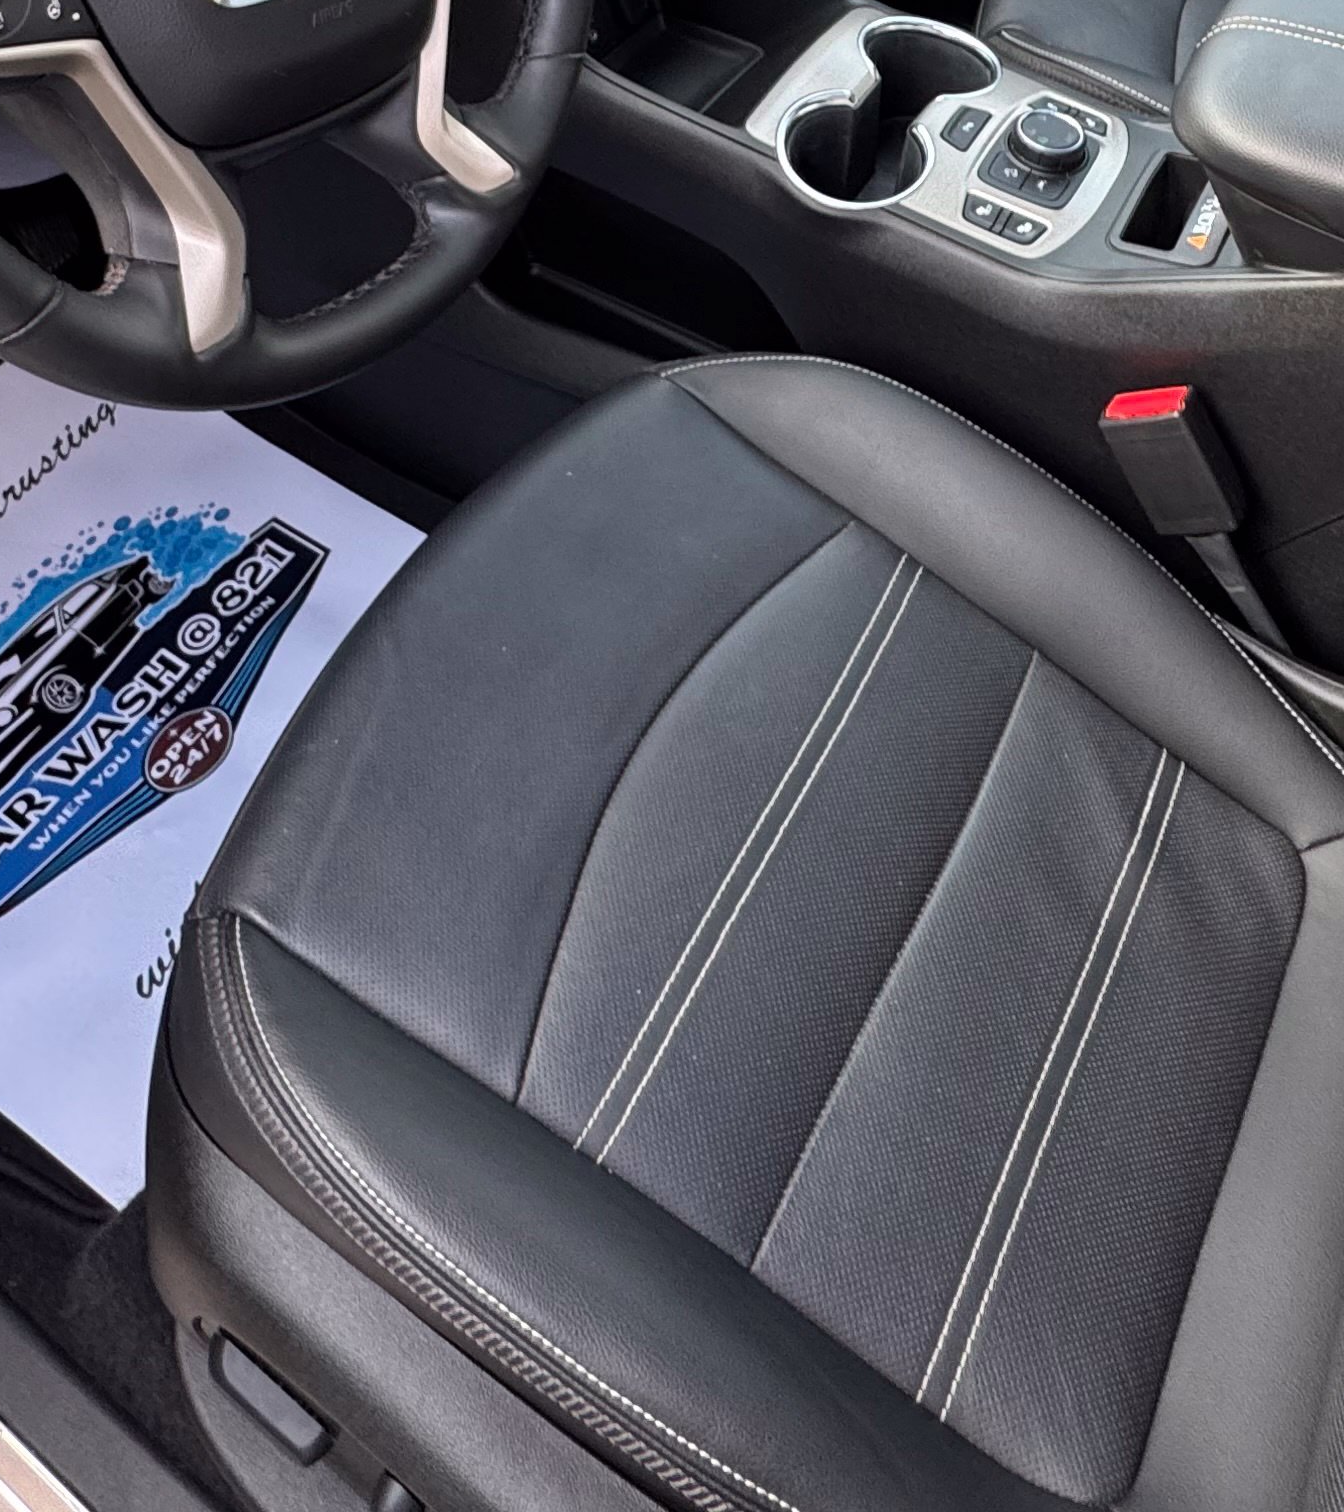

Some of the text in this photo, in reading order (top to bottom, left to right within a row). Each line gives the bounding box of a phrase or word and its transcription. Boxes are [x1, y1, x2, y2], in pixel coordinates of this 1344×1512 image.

[39, 647, 190, 786] WASH
[177, 613, 222, 656] @
[212, 539, 296, 616] 821
[28, 595, 277, 851] WHEN YOU LIKE PERFECTION
[150, 710, 218, 779] OPEN
[169, 724, 225, 784] 24/7
[137, 927, 178, 999] wi
